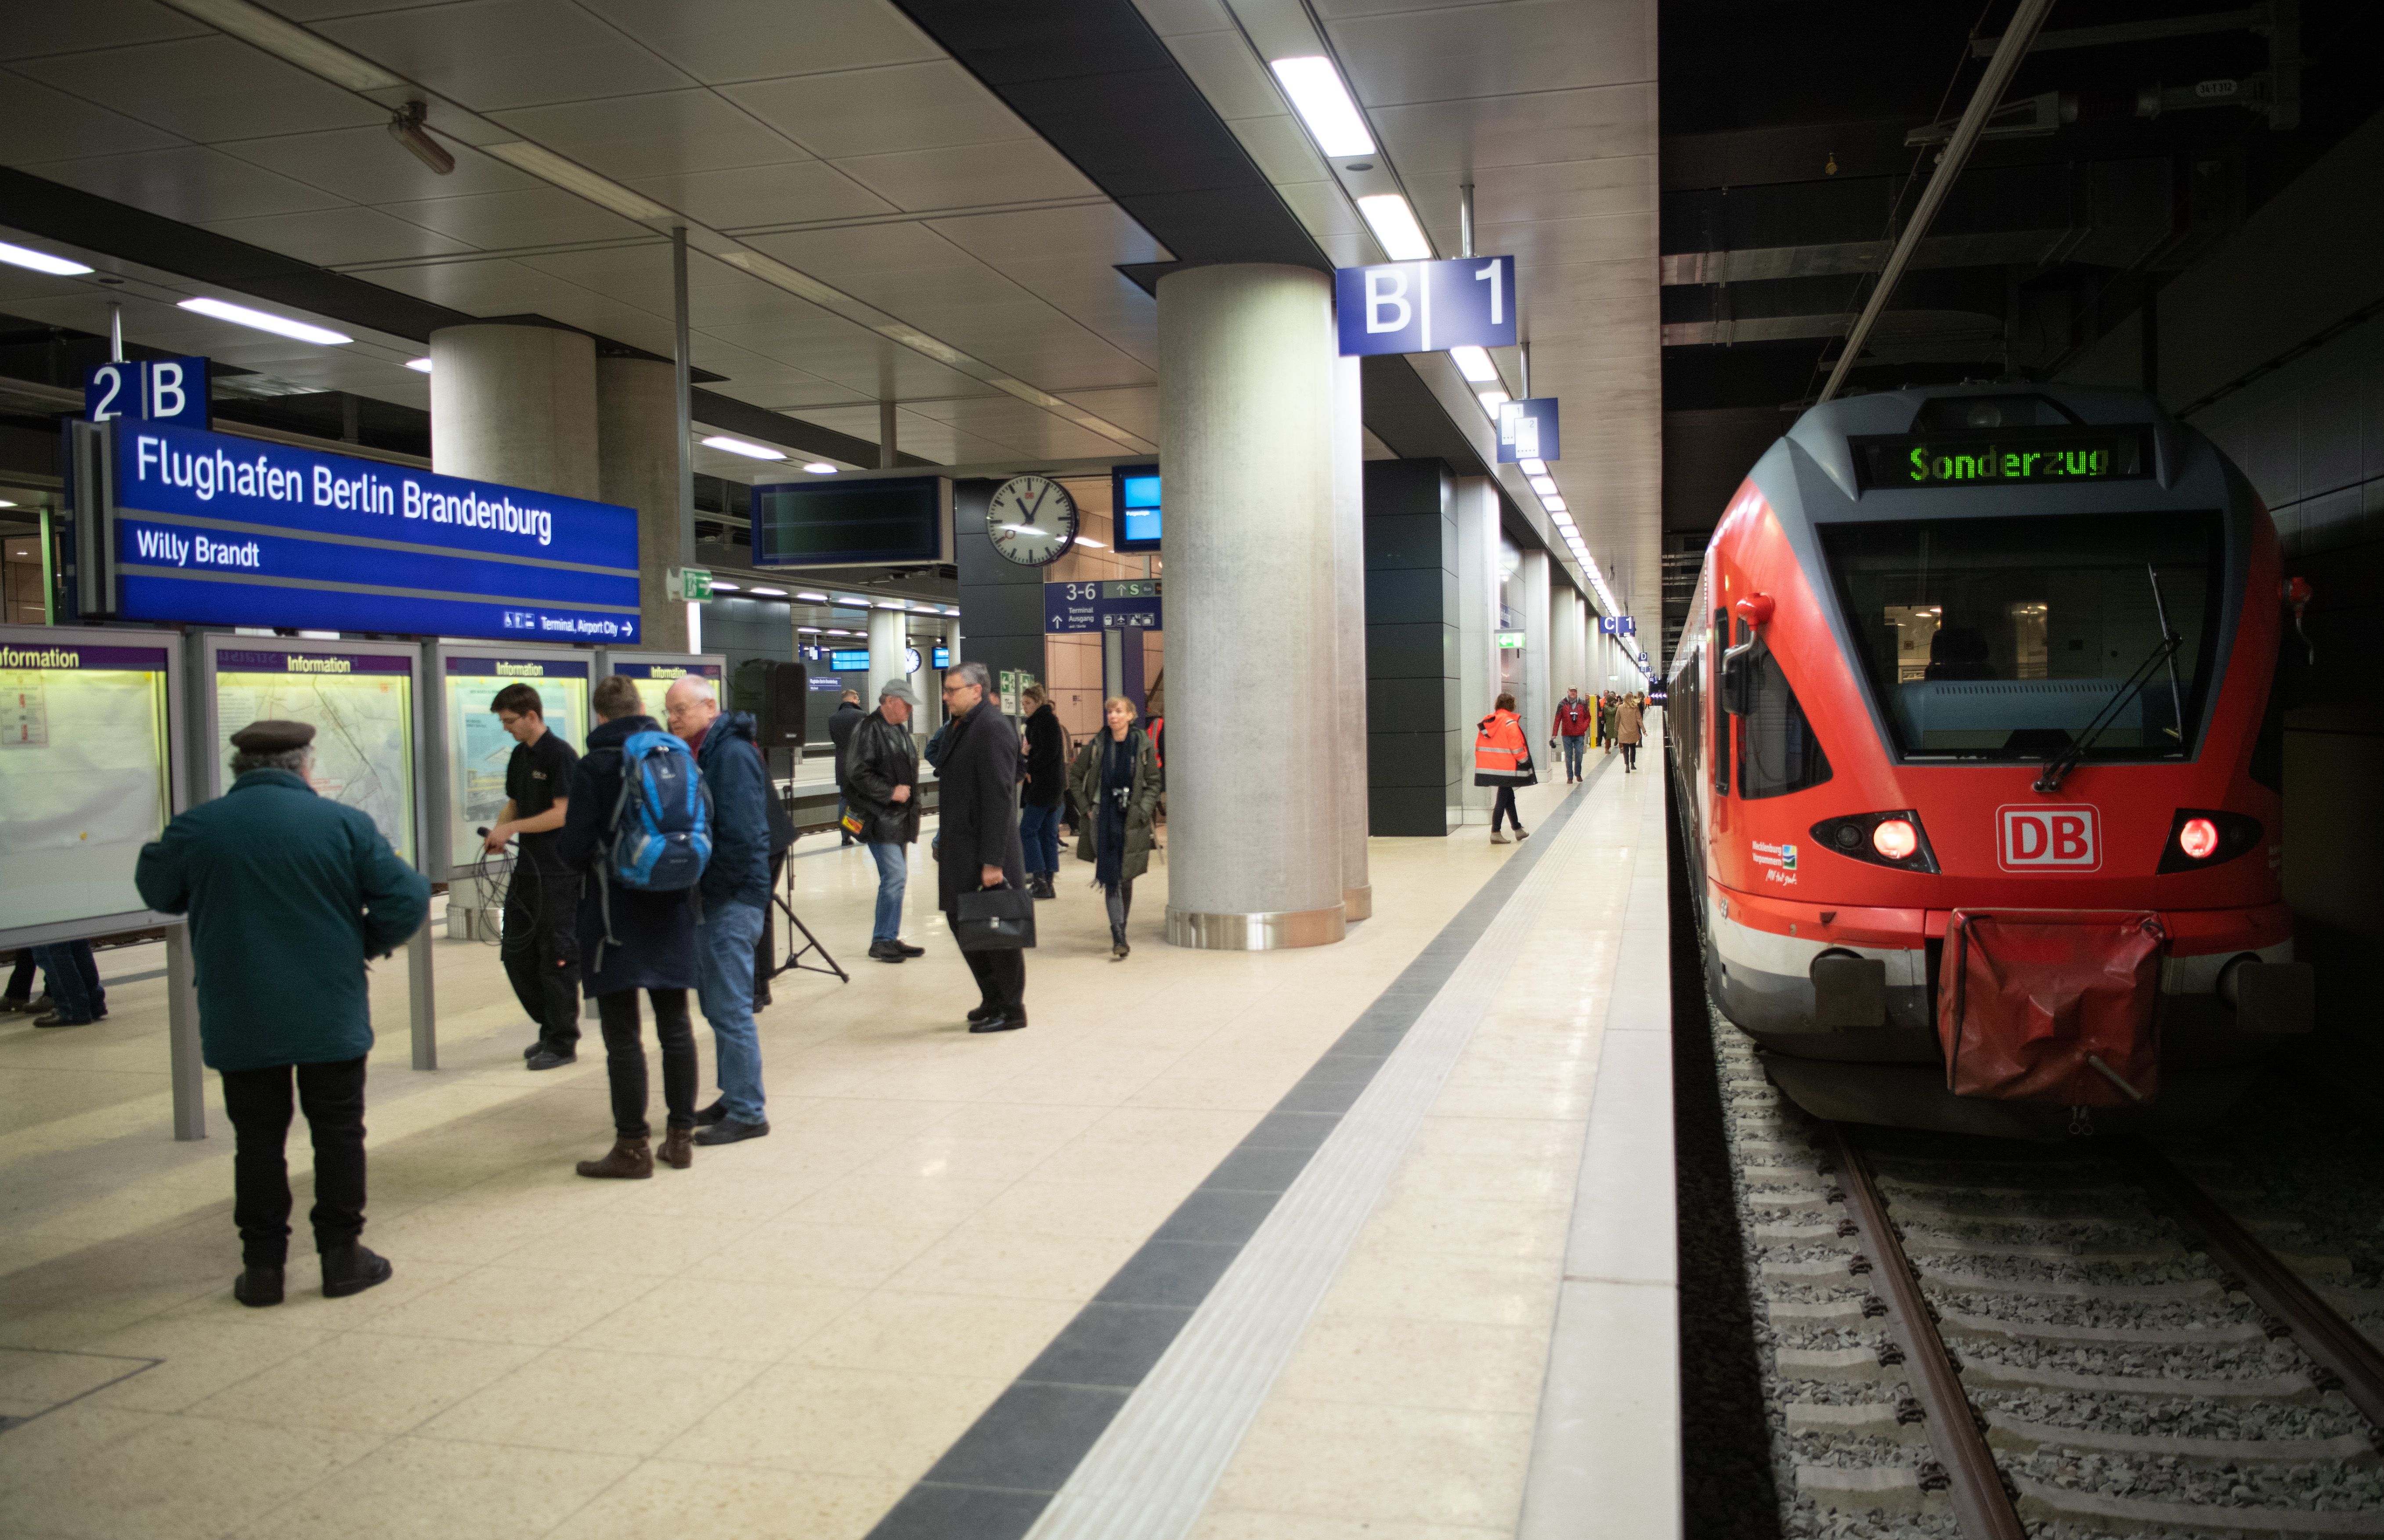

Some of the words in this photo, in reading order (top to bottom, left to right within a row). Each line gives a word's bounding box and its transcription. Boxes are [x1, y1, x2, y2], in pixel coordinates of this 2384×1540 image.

[2219, 82, 2232, 92] 312
[1365, 270, 1411, 334] B
[1475, 259, 1502, 325] 1
[93, 366, 122, 422] 2
[152, 363, 185, 418] B
[1910, 446, 2108, 480] Sonderzug
[137, 436, 303, 503] Flughafen
[313, 465, 394, 516] Berlin
[404, 480, 551, 545] Brandenburg
[137, 529, 190, 566] Willy
[195, 536, 260, 567] Brandt
[1066, 583, 1096, 601] 3-6
[1130, 584, 1139, 595] S
[541, 616, 577, 634] Terminal,
[577, 619, 603, 635] Airport
[603, 621, 618, 637] City
[1604, 617, 1614, 630] C
[1625, 617, 1632, 629] 1
[0, 646, 79, 667] formation
[287, 655, 351, 673] Information
[496, 661, 544, 676] Information
[650, 666, 687, 678] Information
[2011, 815, 2088, 860] DB
[1752, 840, 1782, 857] Mecklenburg
[1752, 852, 1782, 866] Vorpommern
